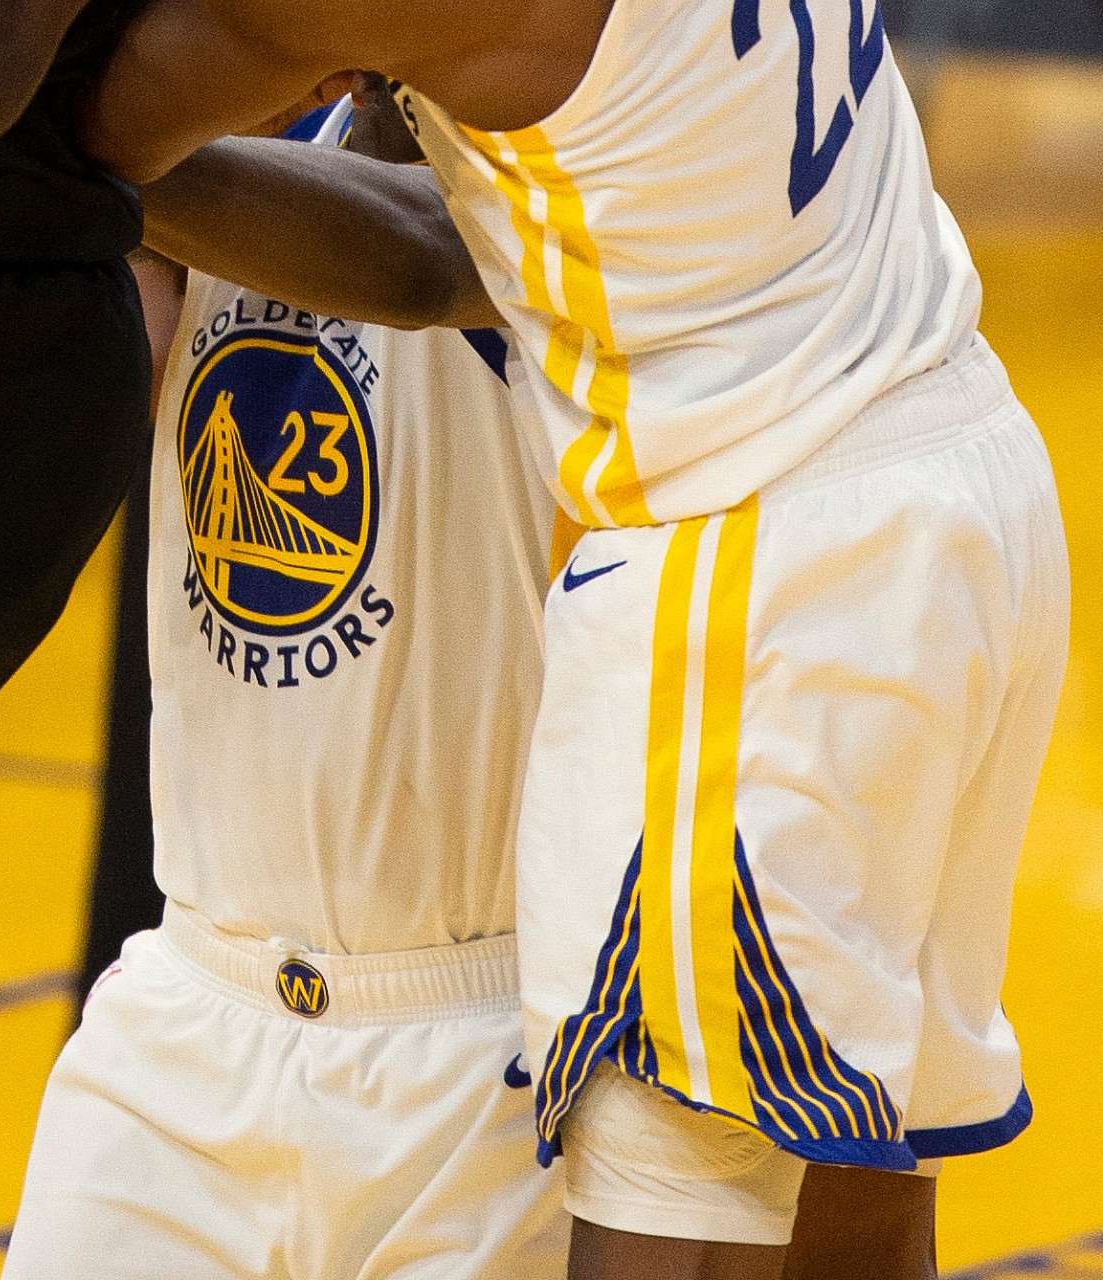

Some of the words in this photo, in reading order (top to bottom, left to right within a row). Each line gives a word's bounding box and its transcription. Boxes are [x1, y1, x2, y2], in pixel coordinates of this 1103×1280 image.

[191, 298, 318, 357] GOLDE
[267, 411, 349, 496] 23
[183, 546, 395, 688] WARRIORS
